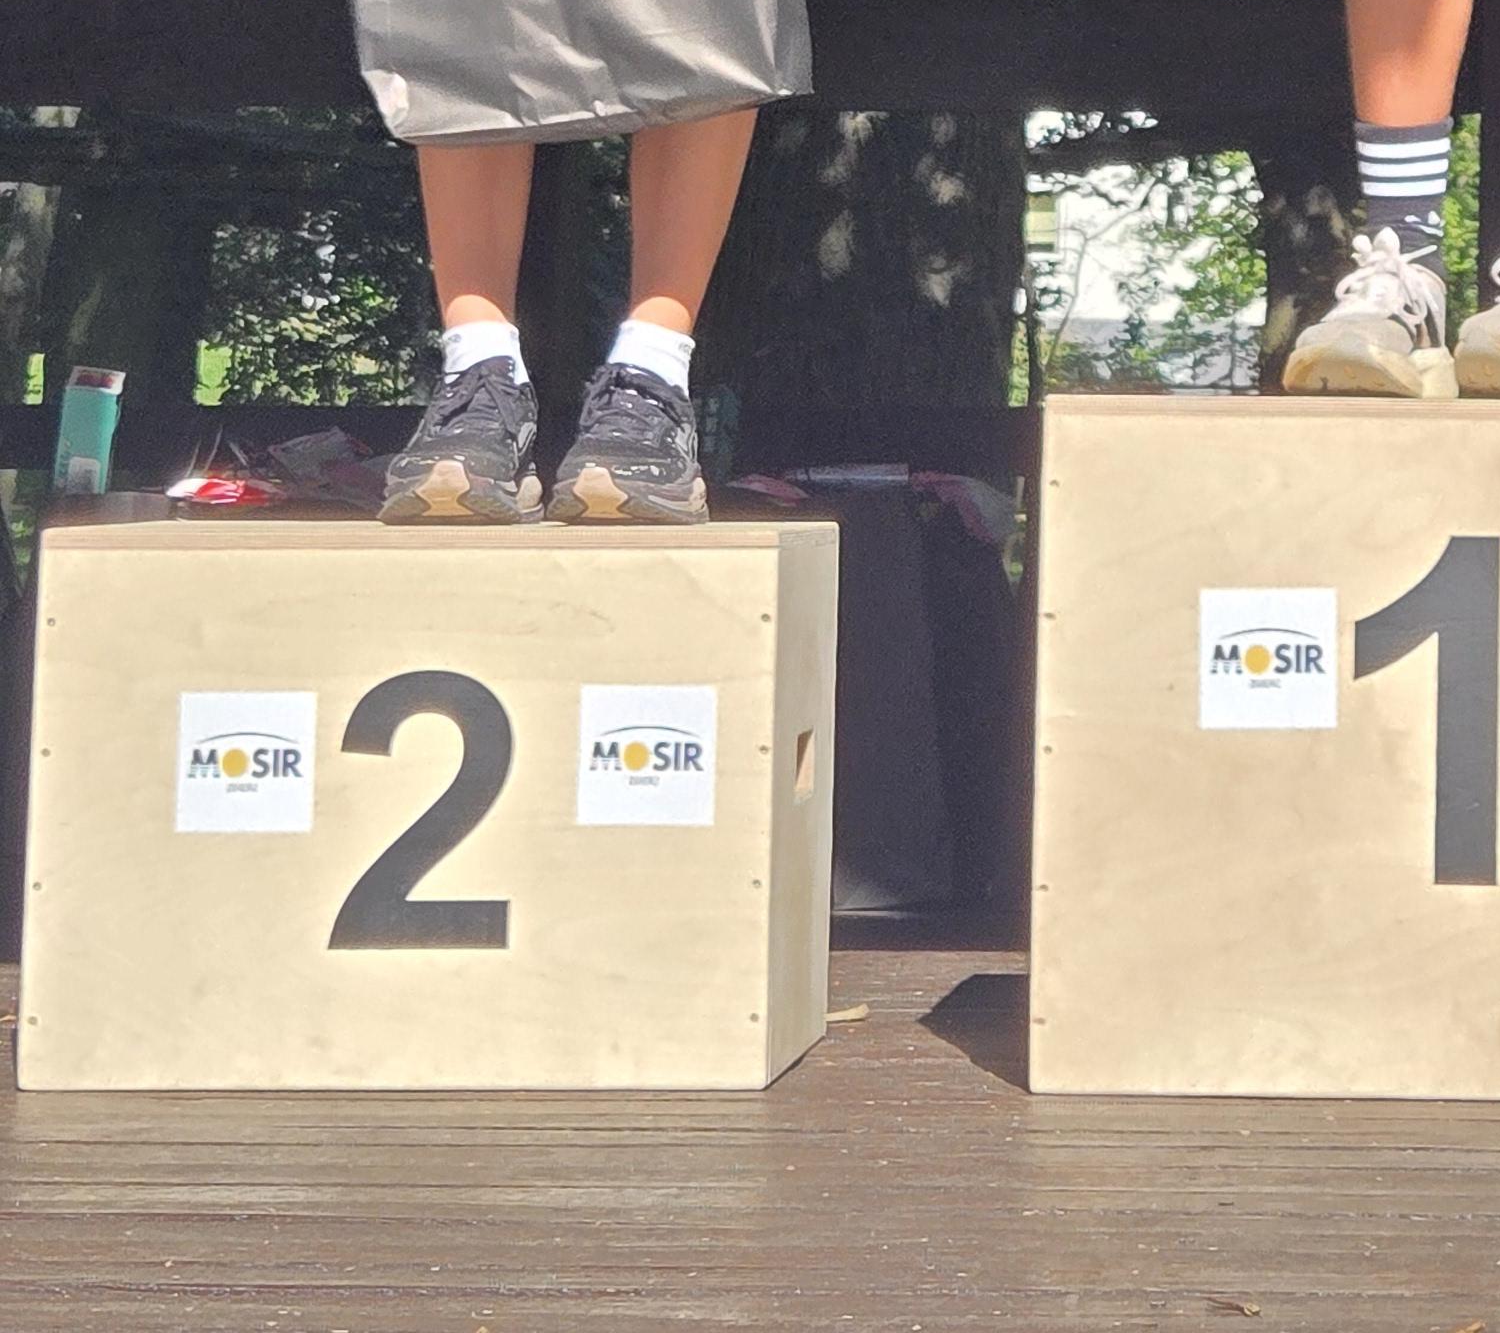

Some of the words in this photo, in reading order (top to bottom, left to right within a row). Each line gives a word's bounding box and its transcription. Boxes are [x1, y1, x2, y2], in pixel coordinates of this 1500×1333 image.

[1209, 643, 1327, 675] MOSIR
[187, 748, 304, 779] MOSIR
[589, 741, 705, 772] MOSIR
[328, 670, 513, 951] 2
